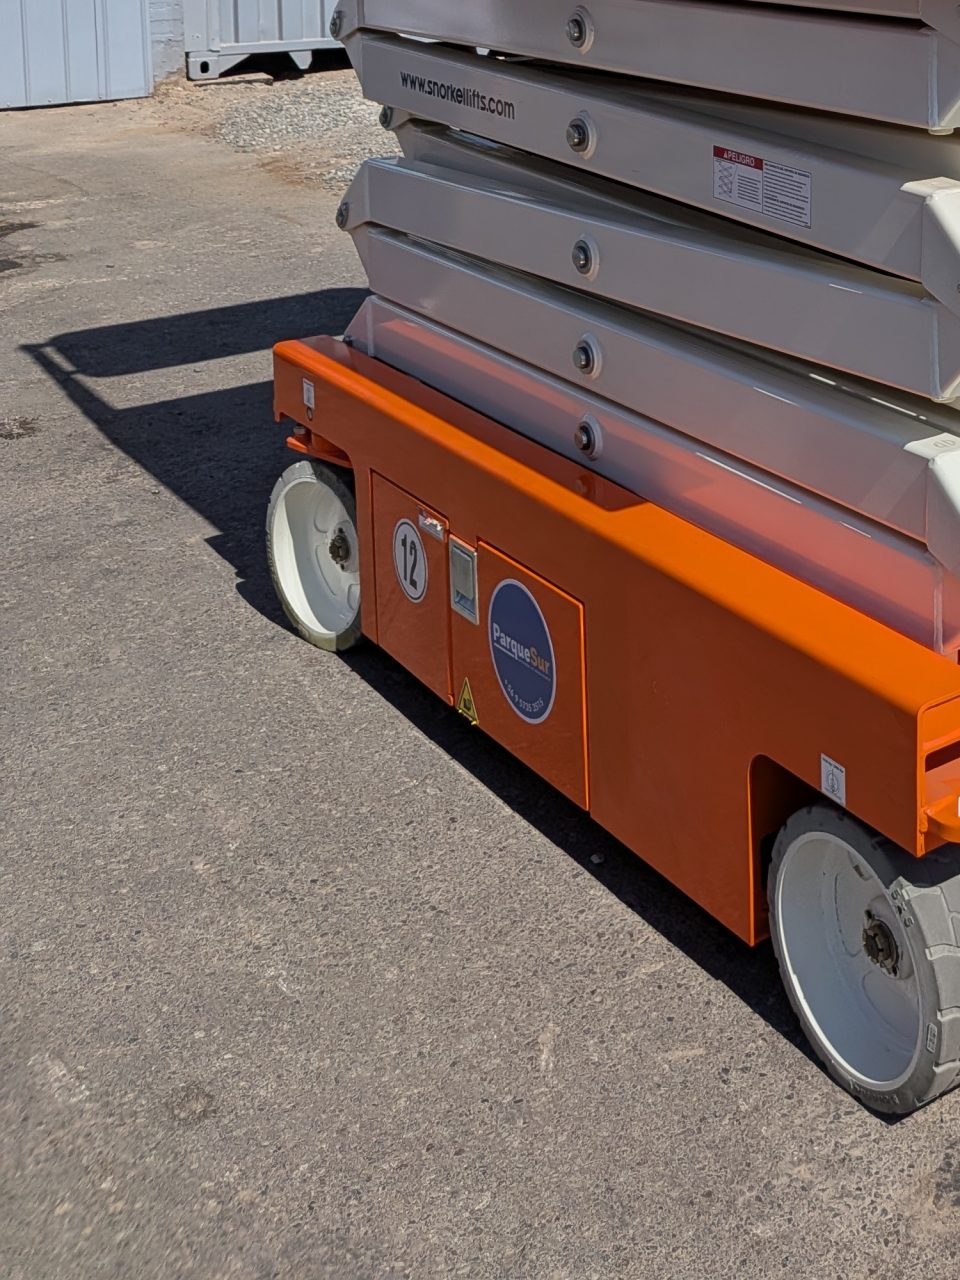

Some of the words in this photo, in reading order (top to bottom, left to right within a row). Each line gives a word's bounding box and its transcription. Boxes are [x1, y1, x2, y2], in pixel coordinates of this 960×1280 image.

[400, 71, 515, 120] www.snorkellifts.com
[727, 151, 755, 167] PELIGRO
[401, 534, 417, 591] 12
[493, 622, 550, 674] ParqueSur
